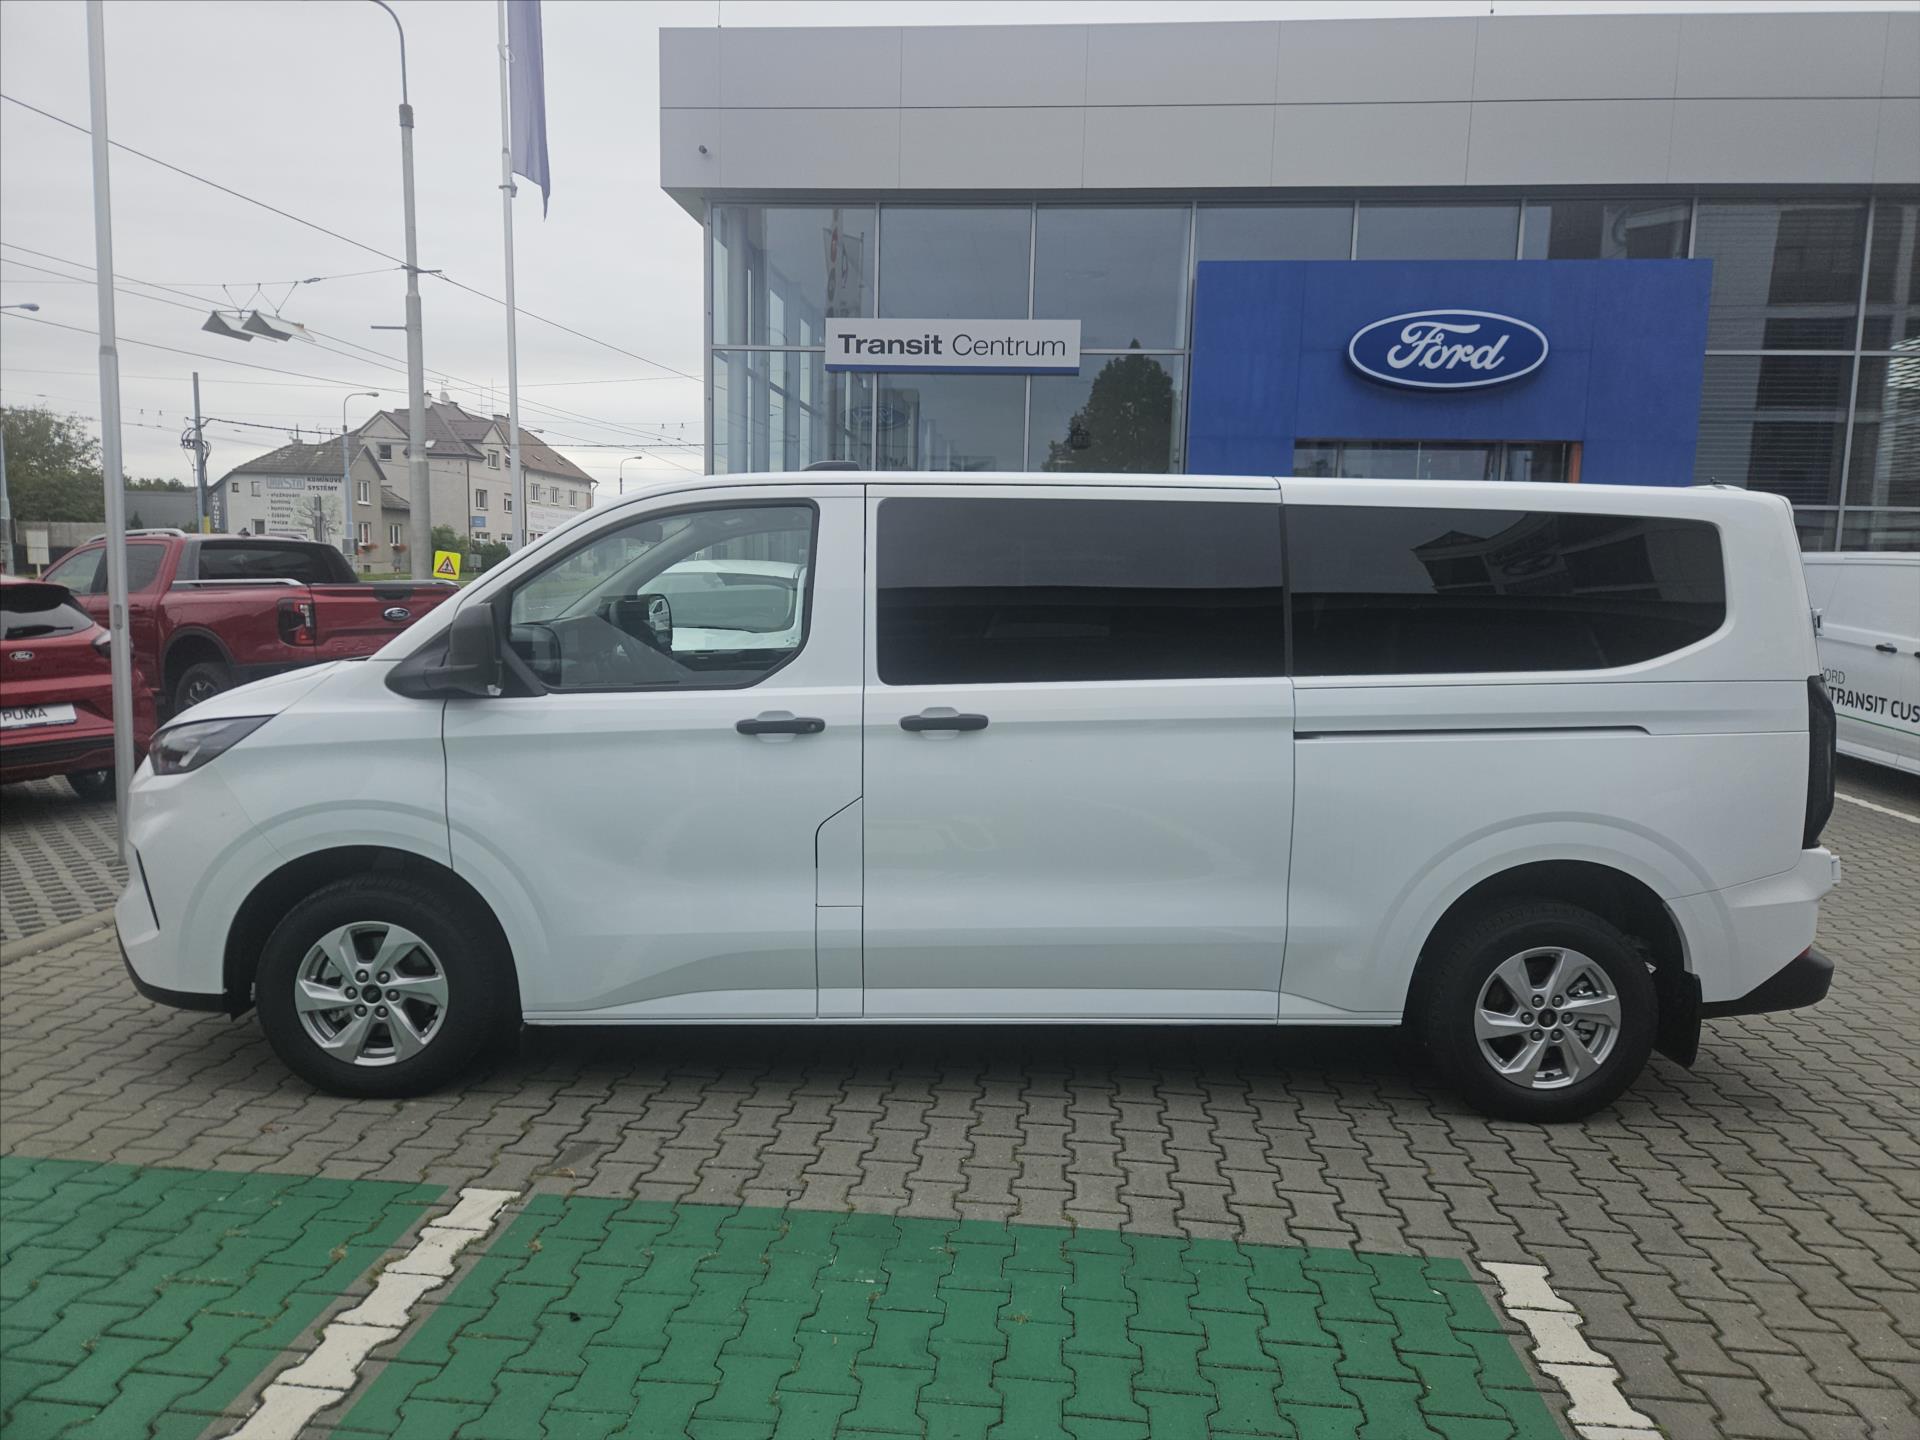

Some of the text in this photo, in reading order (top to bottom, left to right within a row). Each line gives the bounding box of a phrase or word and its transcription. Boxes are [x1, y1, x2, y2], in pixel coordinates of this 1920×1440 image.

[837, 333, 1066, 357] Transit Centrum
[1387, 321, 1510, 370] Ford
[1822, 667, 1845, 685] ORD
[2, 708, 48, 721] PUMA
[1829, 686, 1920, 723] TRANSIT CUS
